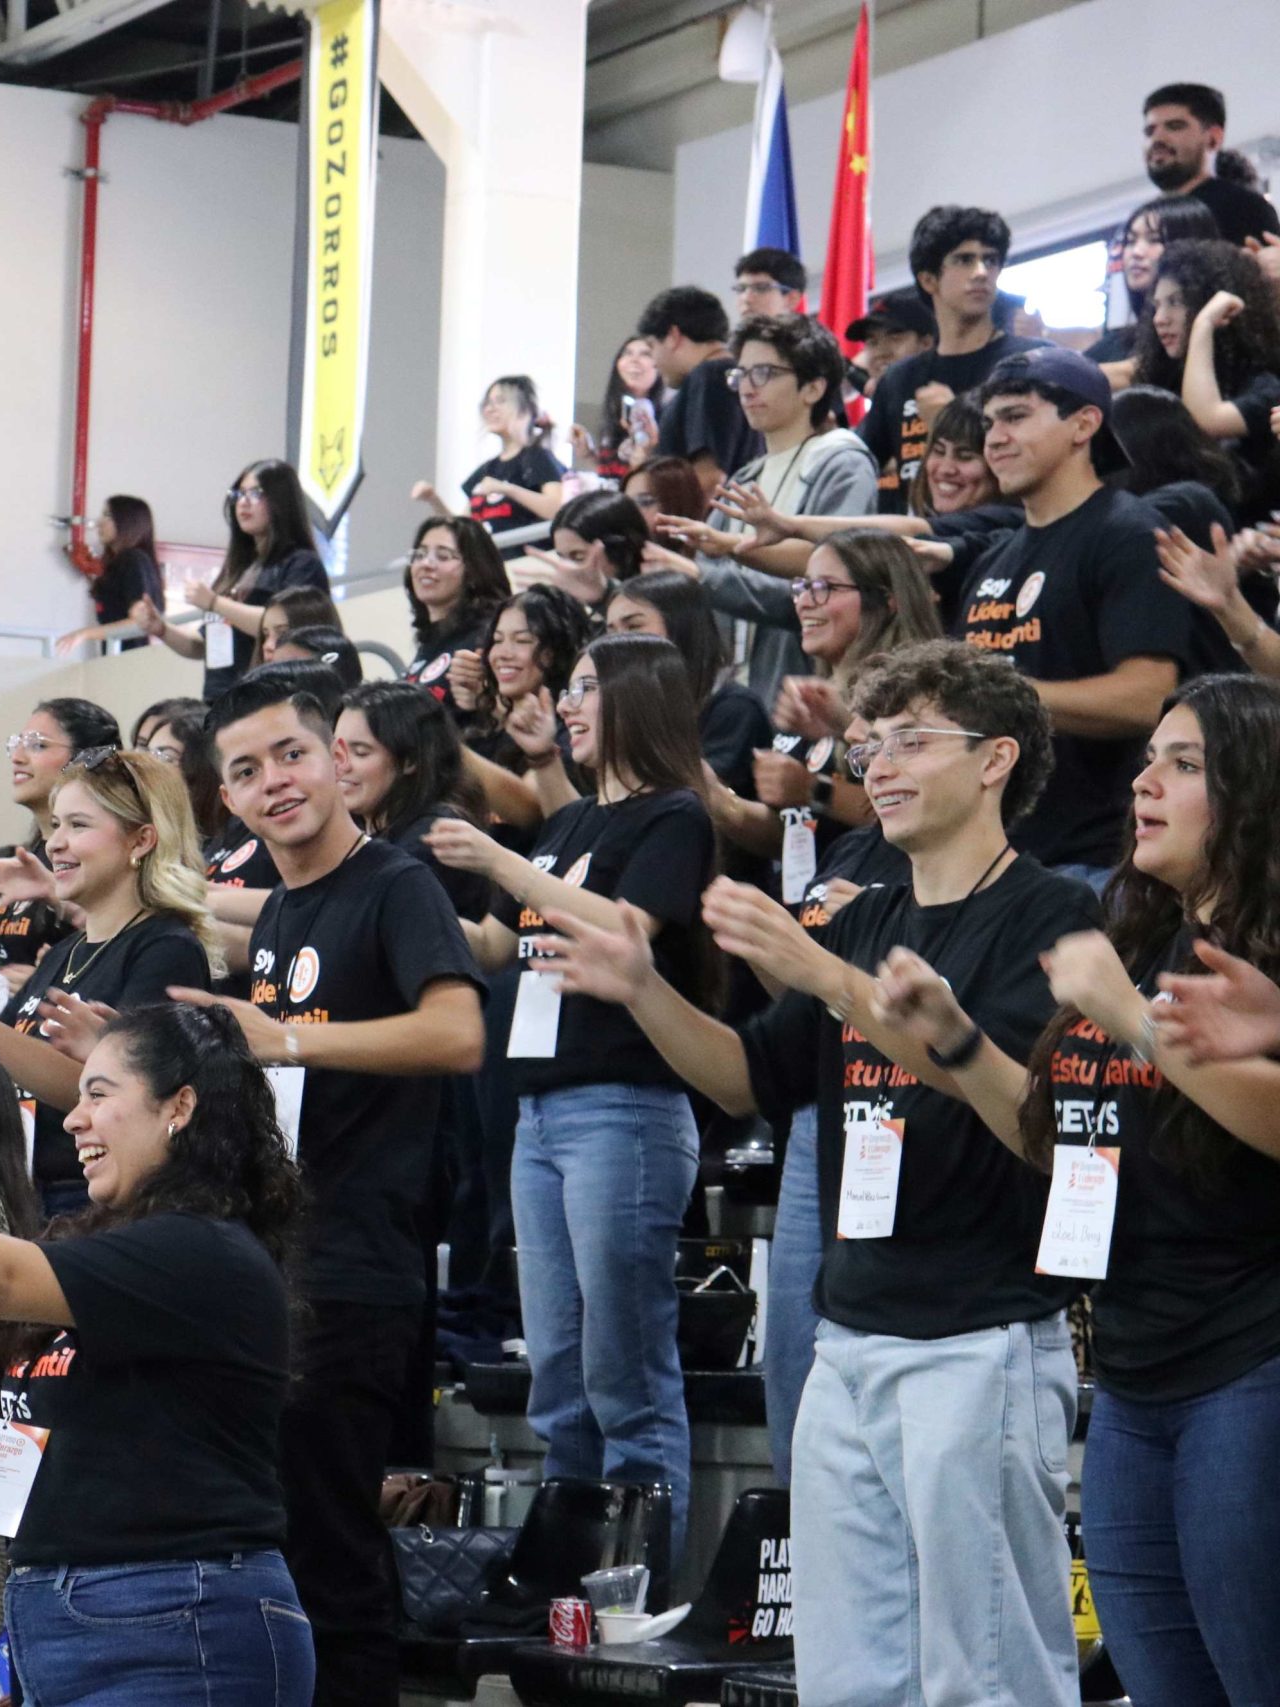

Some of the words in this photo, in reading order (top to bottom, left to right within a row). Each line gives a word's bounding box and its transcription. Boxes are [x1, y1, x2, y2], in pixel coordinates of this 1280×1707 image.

[322, 34, 349, 359] #GOZORROS
[976, 578, 1012, 598] Soy
[751, 1607, 775, 1637] GO
